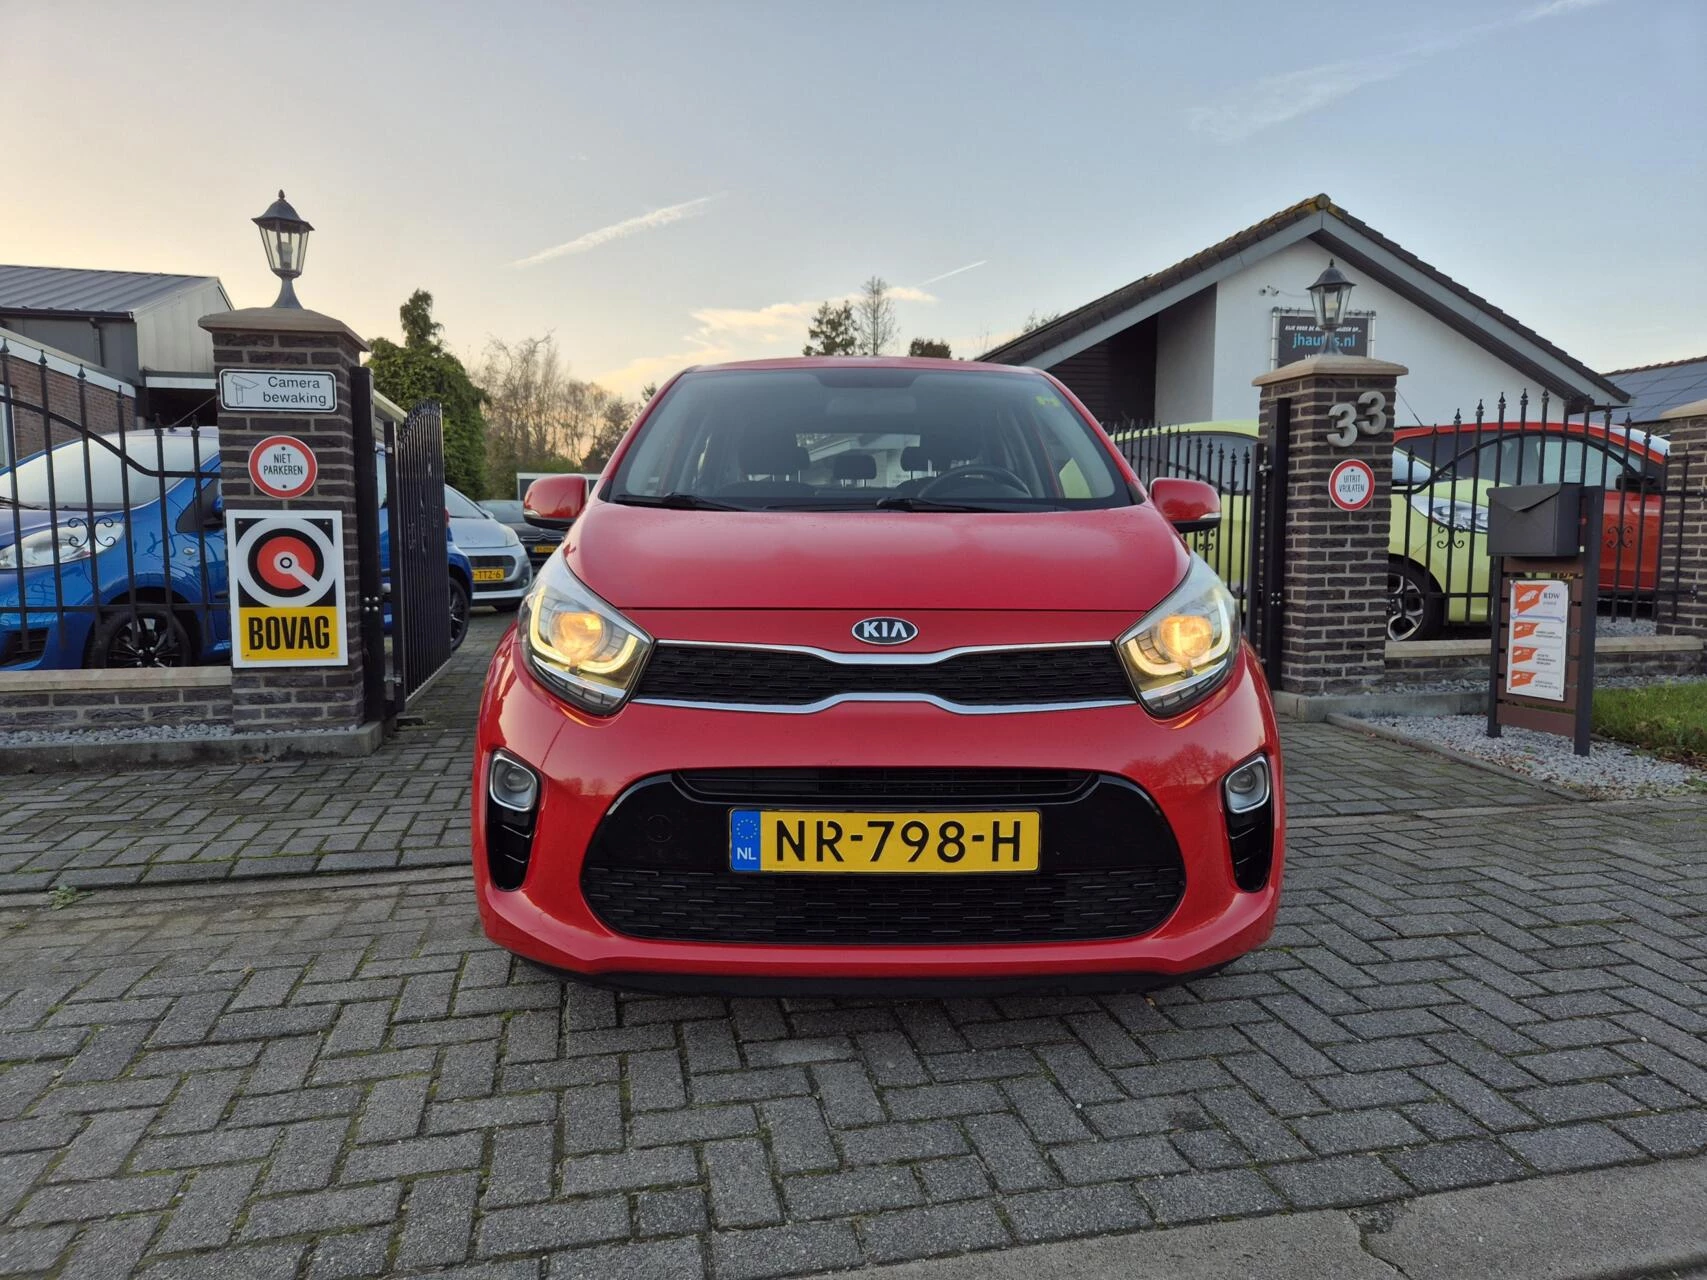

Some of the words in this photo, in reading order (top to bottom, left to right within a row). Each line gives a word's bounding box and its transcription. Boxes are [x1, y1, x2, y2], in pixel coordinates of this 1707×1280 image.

[1293, 333, 1356, 348] jhauts.nl
[268, 376, 320, 389] Camera
[263, 392, 327, 407] bewaking
[1327, 390, 1387, 448] 33
[273, 453, 292, 464] NIET
[263, 465, 303, 476] PARKEREN
[1343, 474, 1361, 483] UITRIT
[473, 570, 502, 579] -TTZ-6
[1543, 592, 1560, 600] RDW
[248, 615, 330, 651] BOVAG
[863, 621, 908, 638] KIA
[736, 847, 757, 860] NL
[776, 820, 1021, 863] NR-798-H
